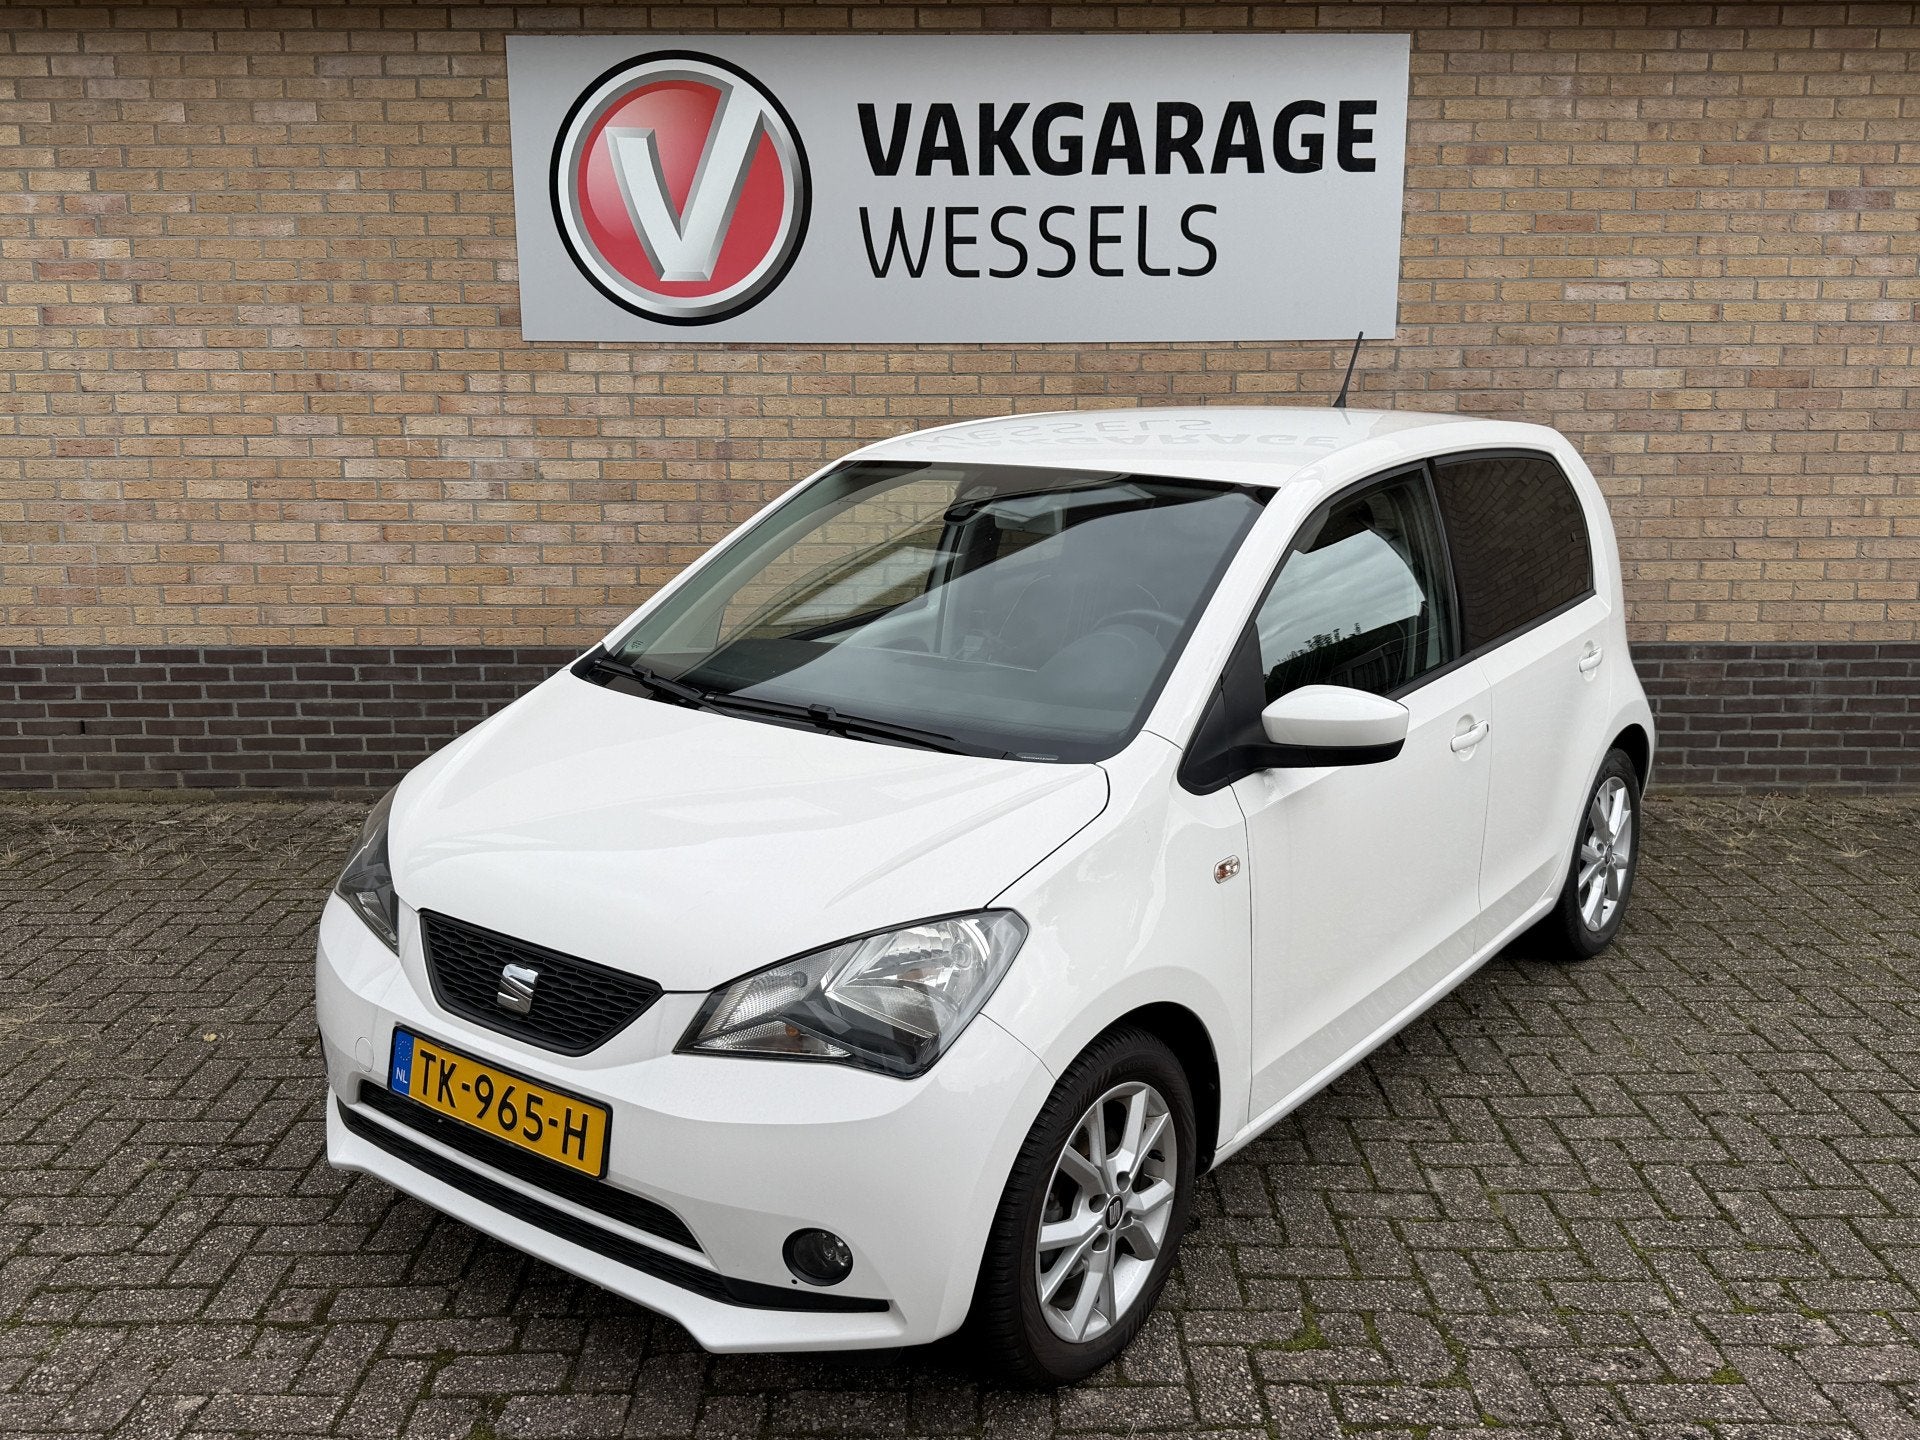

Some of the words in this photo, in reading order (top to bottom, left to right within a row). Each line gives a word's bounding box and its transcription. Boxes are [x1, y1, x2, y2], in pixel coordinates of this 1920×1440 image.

[857, 99, 1378, 176] VAKGARAGE
[858, 203, 1218, 278] WESSELS
[395, 1066, 408, 1084] NL
[420, 1048, 589, 1161] TK-965-H
